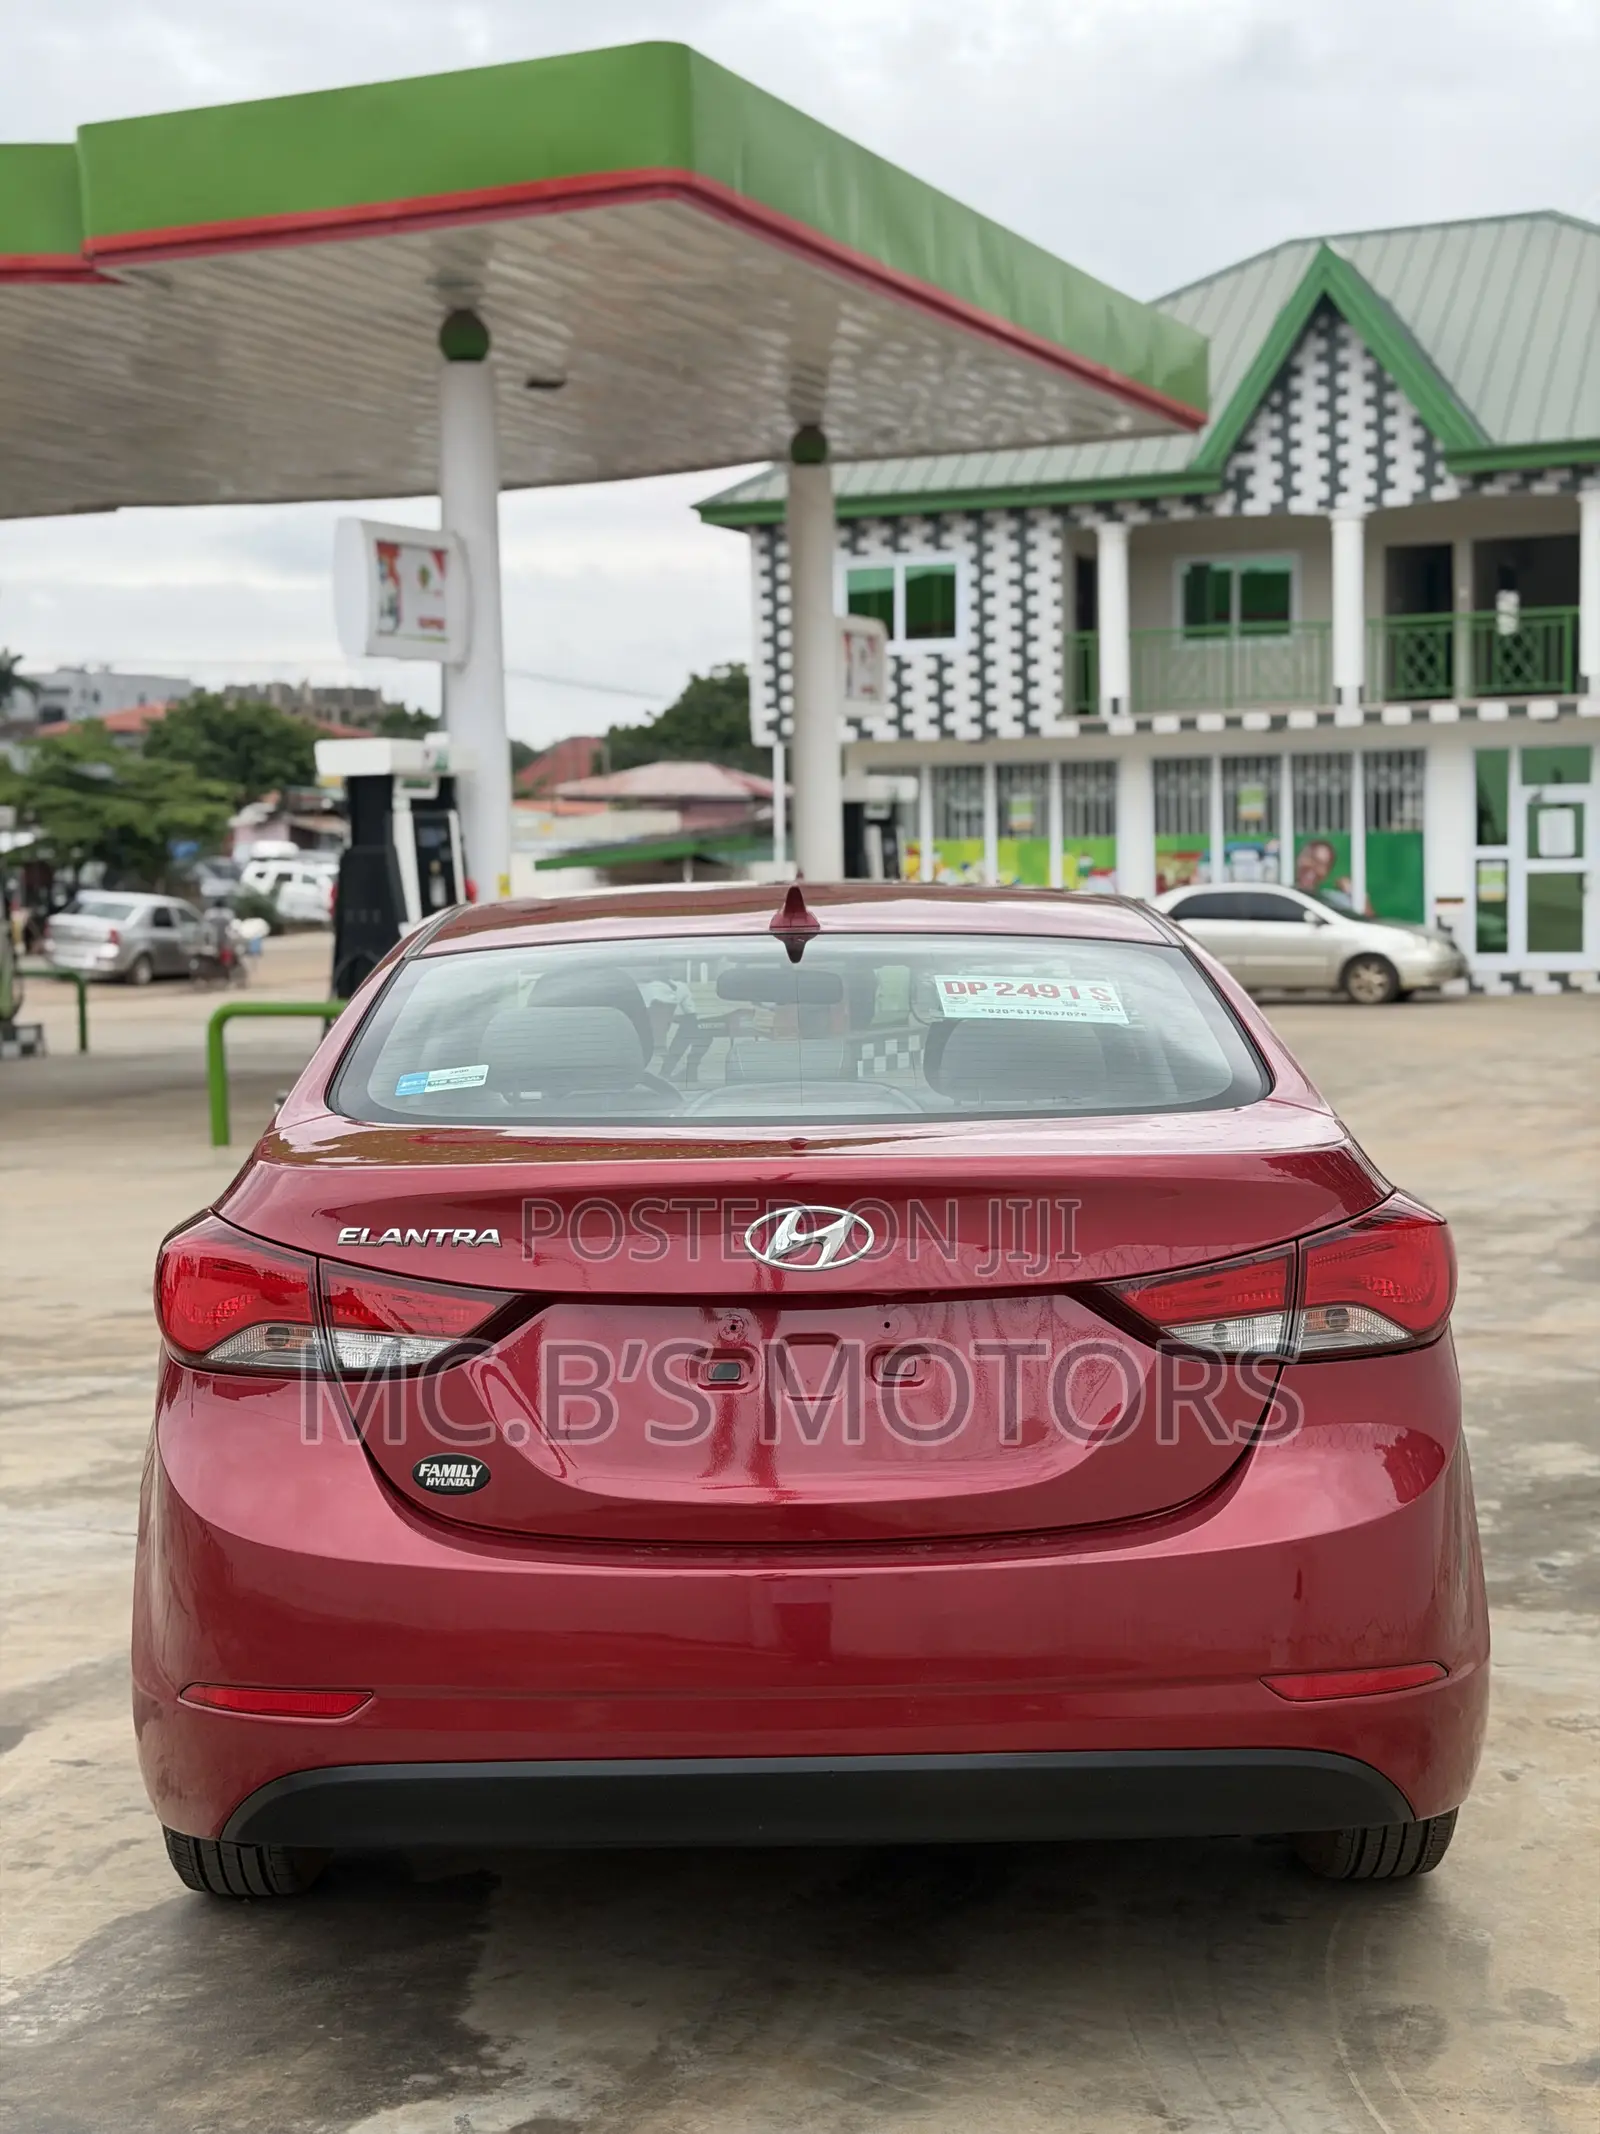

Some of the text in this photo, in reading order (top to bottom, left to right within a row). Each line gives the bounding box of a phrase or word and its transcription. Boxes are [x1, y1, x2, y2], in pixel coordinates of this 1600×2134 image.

[943, 981, 987, 995] DP
[993, 982, 1080, 999] 2491
[337, 1227, 502, 1247] ELANTRA
[418, 1463, 483, 1478] FAMILY
[425, 1477, 476, 1487] HYUNDAI
